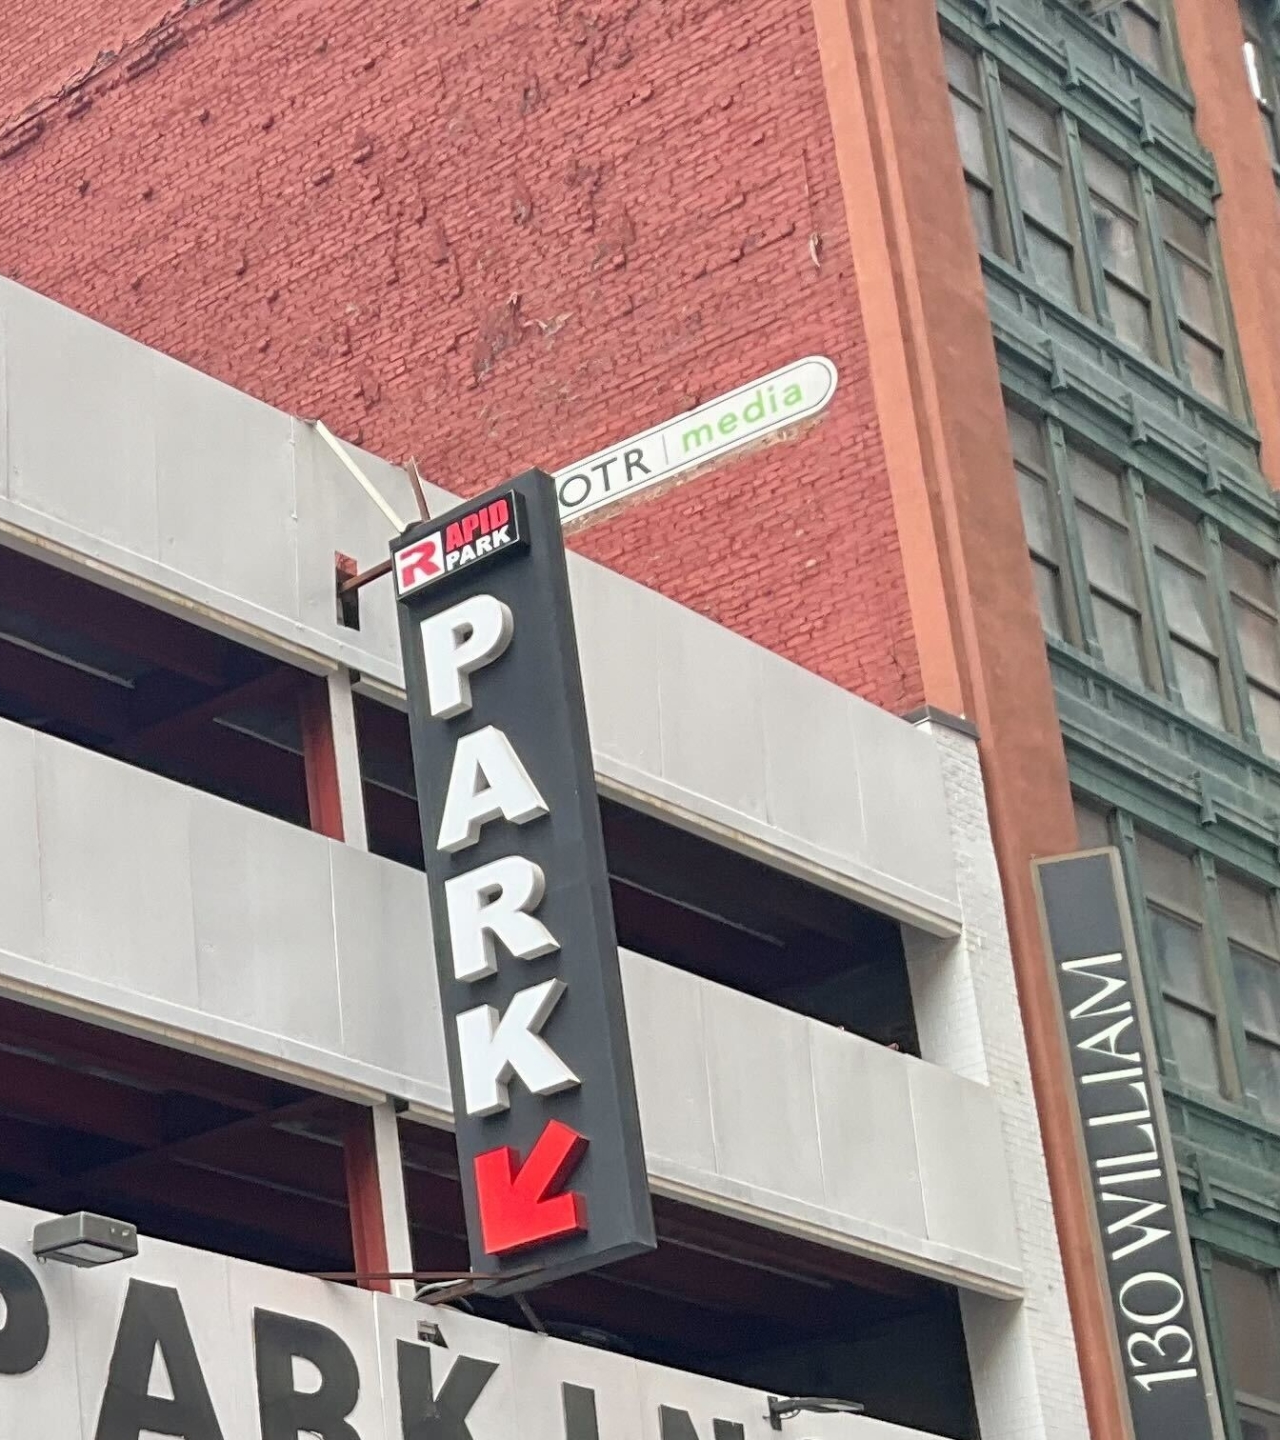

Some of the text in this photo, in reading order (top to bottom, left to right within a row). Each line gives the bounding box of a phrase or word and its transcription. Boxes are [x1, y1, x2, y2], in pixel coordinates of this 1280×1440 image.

[446, 525, 511, 572] PARK
[559, 383, 803, 507] OTR media
[420, 595, 581, 1117] PARK
[1062, 952, 1197, 1392] 130 WILLIAM
